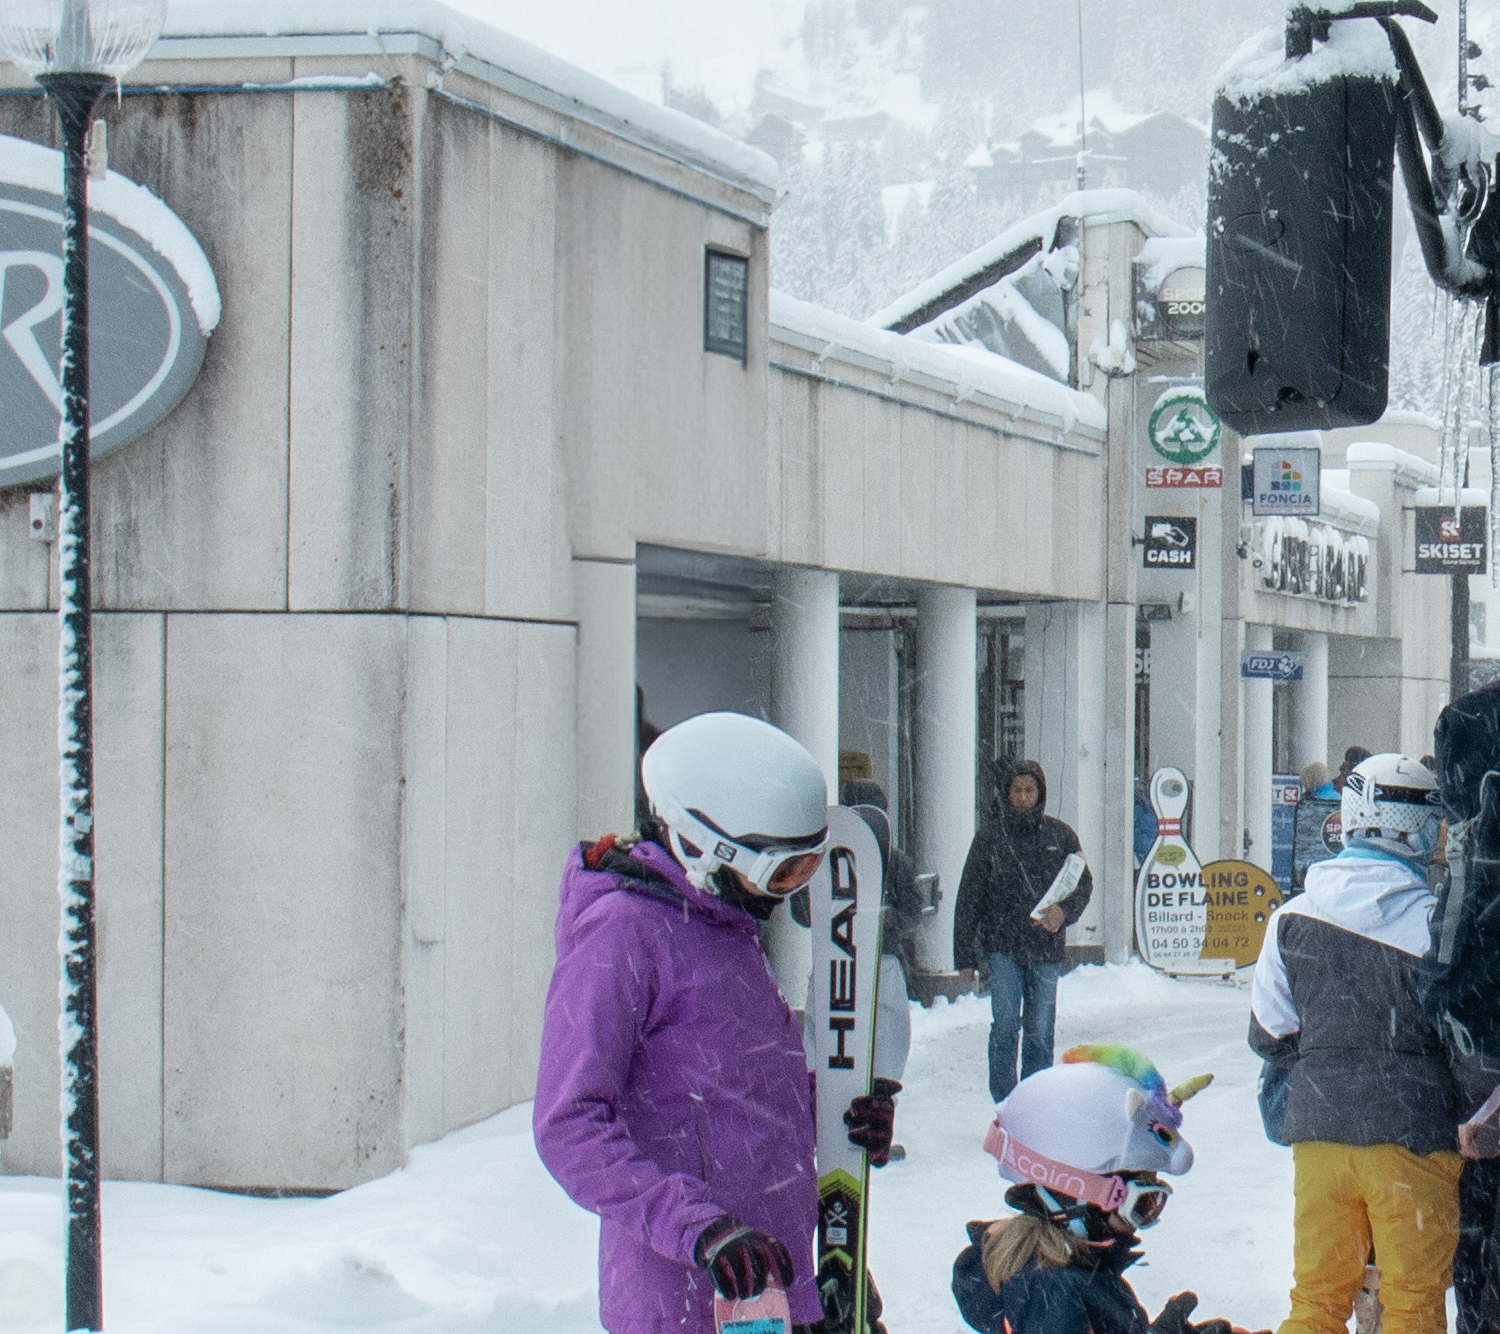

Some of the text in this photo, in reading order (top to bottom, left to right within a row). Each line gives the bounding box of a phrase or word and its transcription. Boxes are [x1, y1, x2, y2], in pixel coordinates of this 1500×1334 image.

[1147, 469, 1221, 485] SPAR
[1259, 493, 1312, 504] FONCIA
[1146, 549, 1192, 564] CASH
[1417, 543, 1484, 559] SKISET
[1250, 657, 1276, 671] FDJ
[1326, 823, 1342, 833] SP
[1147, 871, 1249, 888] BOWLING
[1147, 890, 1249, 907] DE FLAINE
[1148, 910, 1194, 923] Billard
[1206, 910, 1249, 922] Snack
[1151, 925, 1179, 934] 17h00
[1151, 936, 1250, 950] 04 50 34 04 72
[827, 845, 858, 1070] HEAD
[1017, 1155, 1087, 1197] cairn
